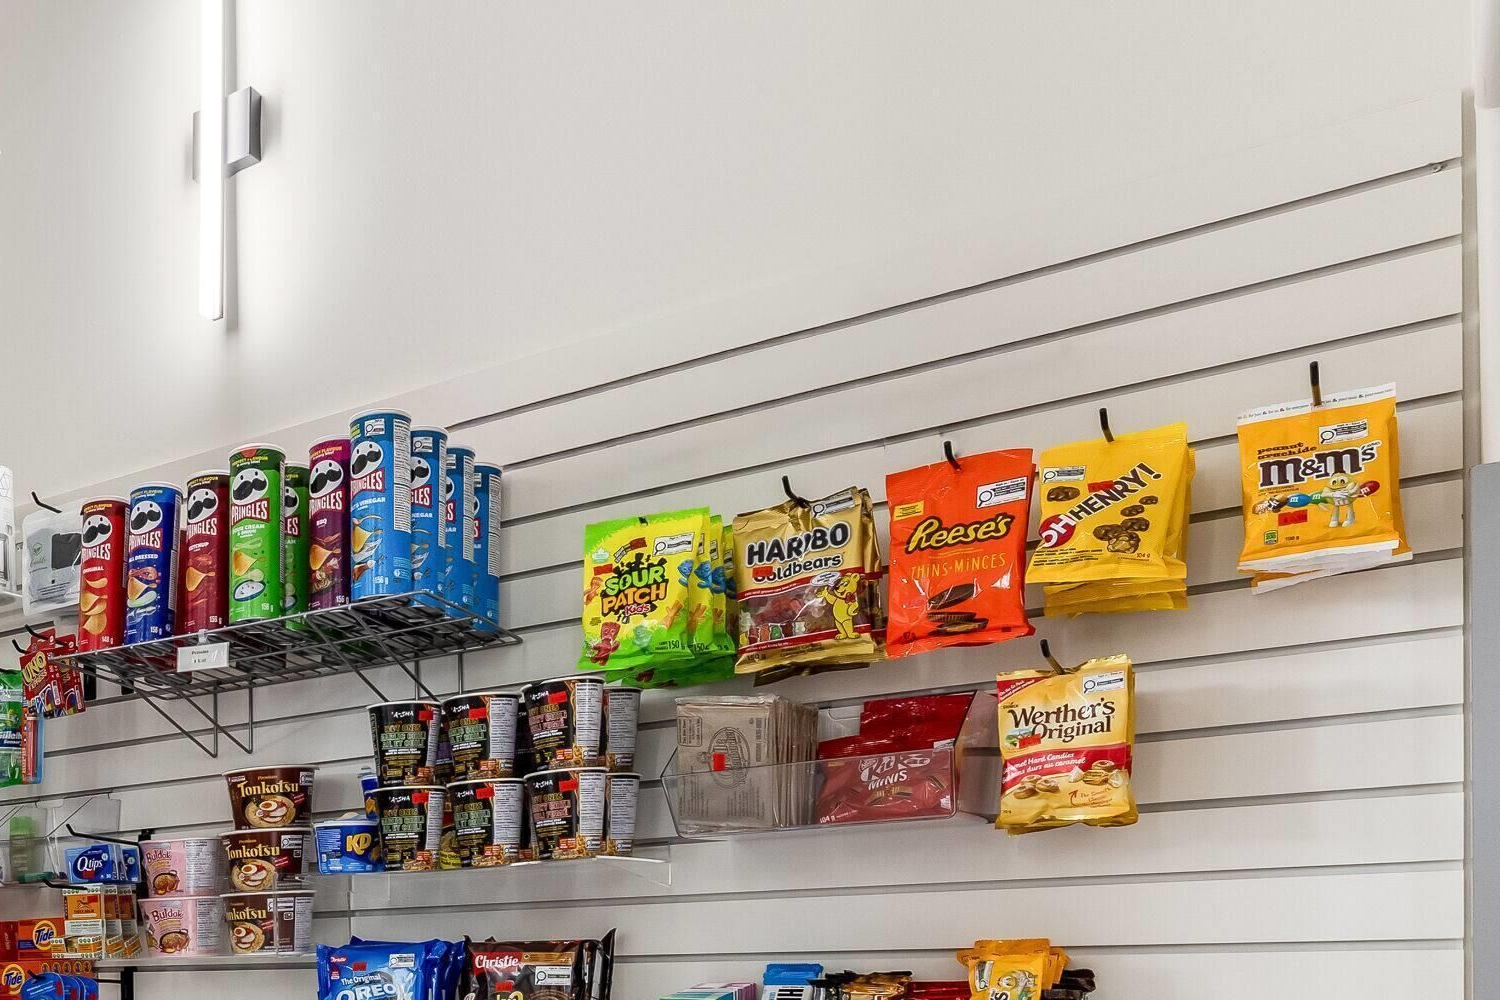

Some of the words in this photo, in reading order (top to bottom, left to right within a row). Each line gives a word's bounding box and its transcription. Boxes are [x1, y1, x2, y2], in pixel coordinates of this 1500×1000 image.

[1257, 442, 1304, 455] peanut
[1257, 446, 1317, 460] arachide
[1260, 447, 1376, 487] m&m's
[351, 471, 383, 497] PRINGLES
[1069, 462, 1162, 521] HENRY!
[231, 500, 268, 525] PRINGLES
[310, 490, 343, 517] PRINGLES
[907, 515, 1011, 552] Reese's
[1041, 514, 1076, 548] OH
[747, 522, 850, 566] HARIBO
[605, 565, 664, 596] SOUR
[602, 582, 668, 615] PATCH
[625, 604, 650, 616] Kids
[668, 640, 680, 650] 150
[22, 651, 47, 684] UNO
[1008, 697, 1116, 728] Werther's
[1032, 716, 1111, 743] Original
[1027, 764, 1042, 773] durs
[1056, 757, 1086, 768] caramel
[1028, 756, 1046, 764] Hard
[1047, 752, 1074, 761] Candies
[237, 780, 299, 798] Tonkotsu
[868, 770, 908, 790] MINIS
[225, 844, 280, 860] Tonkotsu
[346, 833, 372, 854] KD
[146, 850, 171, 863] Buldak
[151, 909, 183, 921] Buldak
[227, 907, 267, 921] nkotsu
[35, 928, 54, 944] Tide
[475, 955, 518, 968] Christie
[3, 973, 22, 986] Tide
[353, 974, 381, 983] Original
